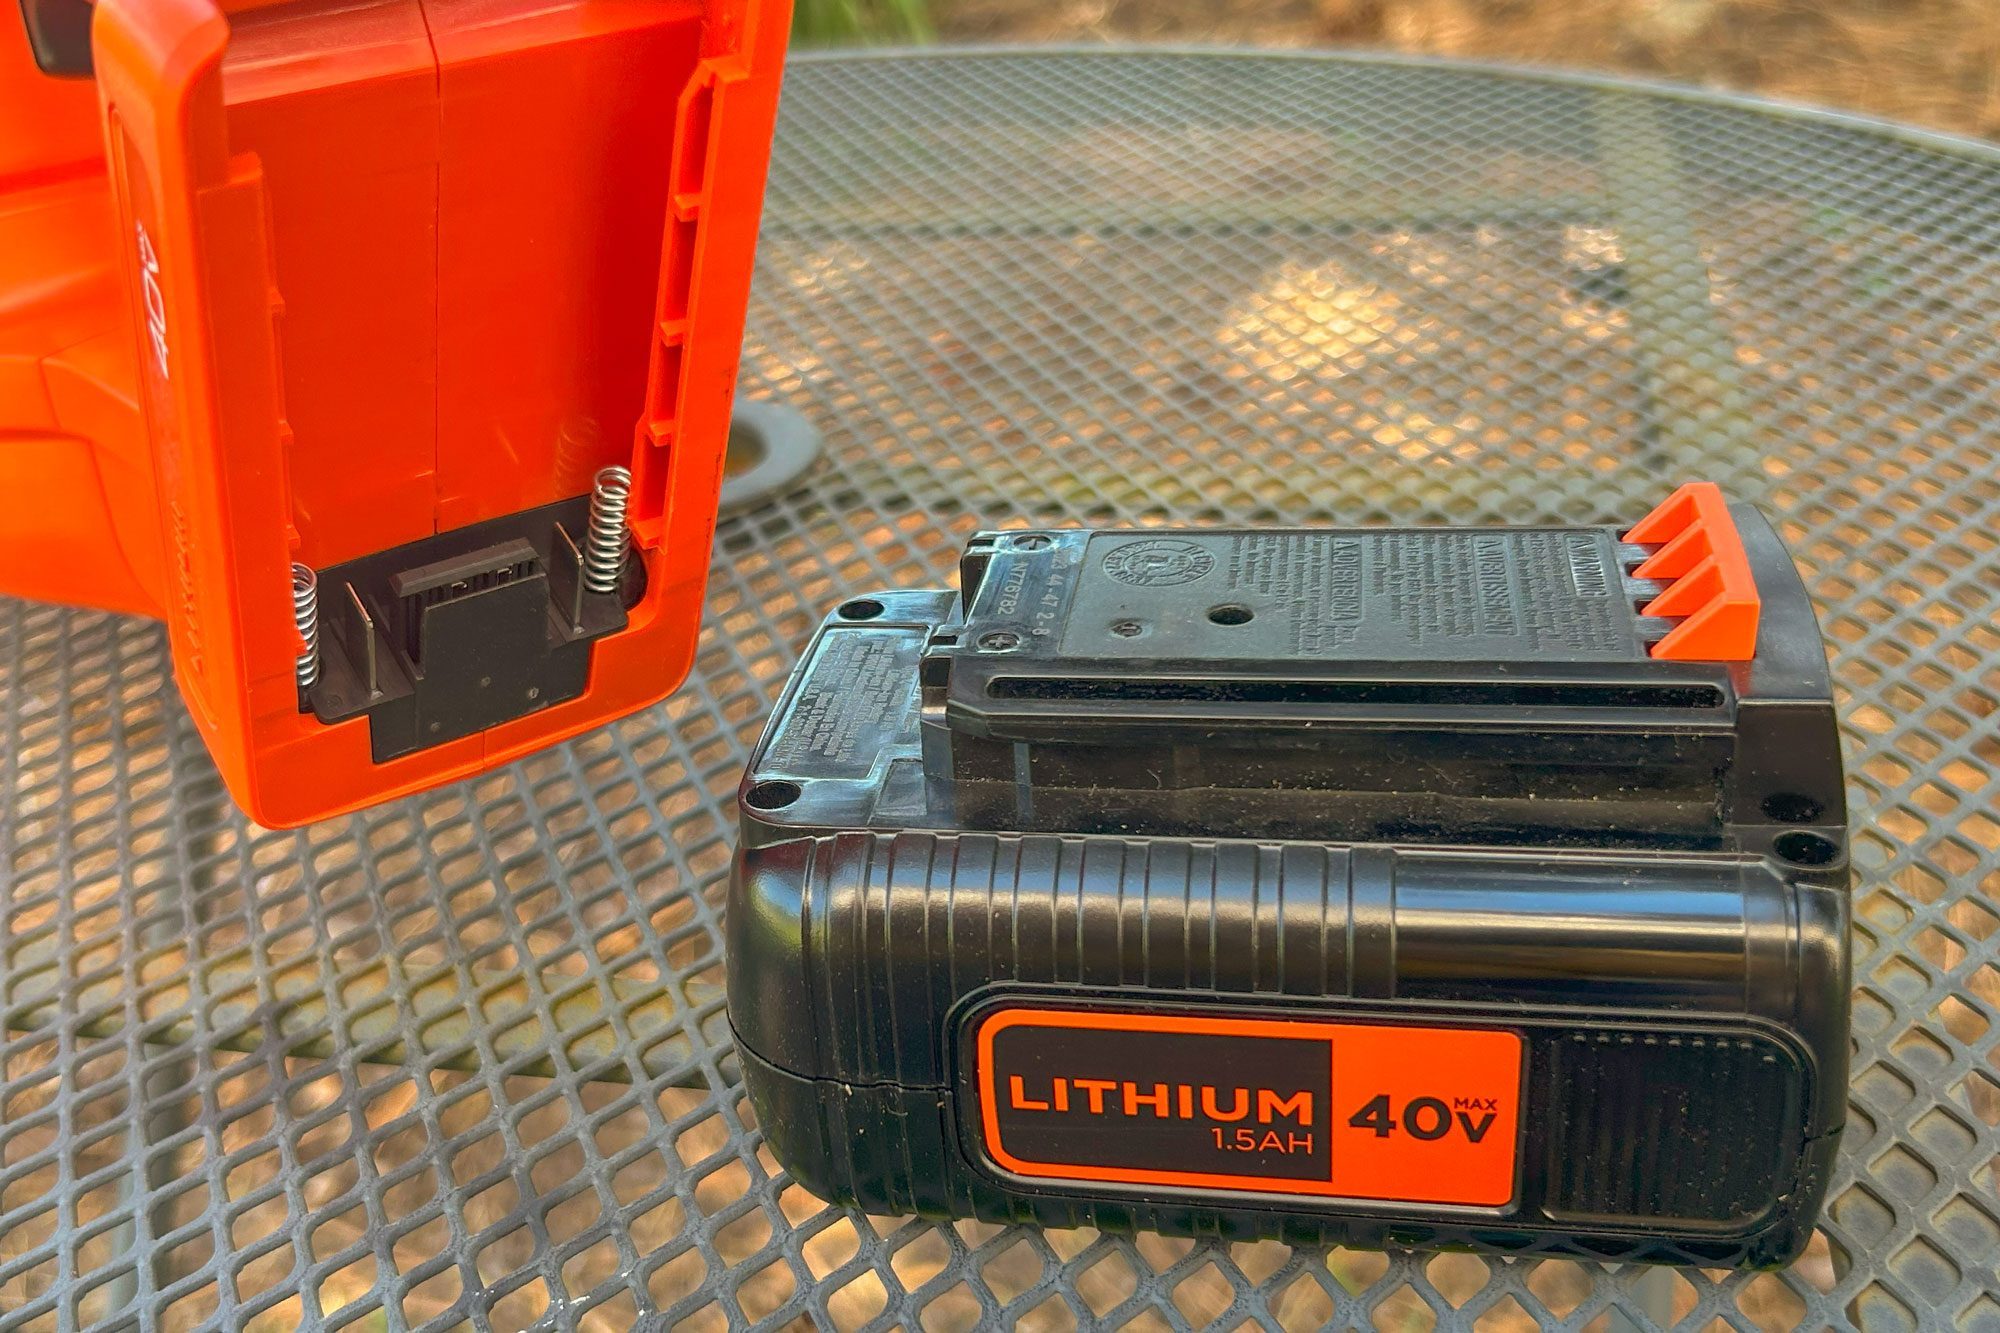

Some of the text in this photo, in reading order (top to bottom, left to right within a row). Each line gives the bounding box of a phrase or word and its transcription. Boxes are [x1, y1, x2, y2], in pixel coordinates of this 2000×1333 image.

[997, 562, 1029, 615] N776782
[1040, 574, 1064, 607] 44-47
[1328, 551, 1361, 620] ADVERTENCIA
[1476, 550, 1514, 635] AVERTISSEMENT
[1567, 548, 1608, 596] WARNING
[1031, 612, 1055, 636] 2-8
[1009, 1075, 1496, 1144] LITHIUM 40V
[1453, 1097, 1497, 1112] MAX
[1211, 1127, 1313, 1155] 1.5AH
